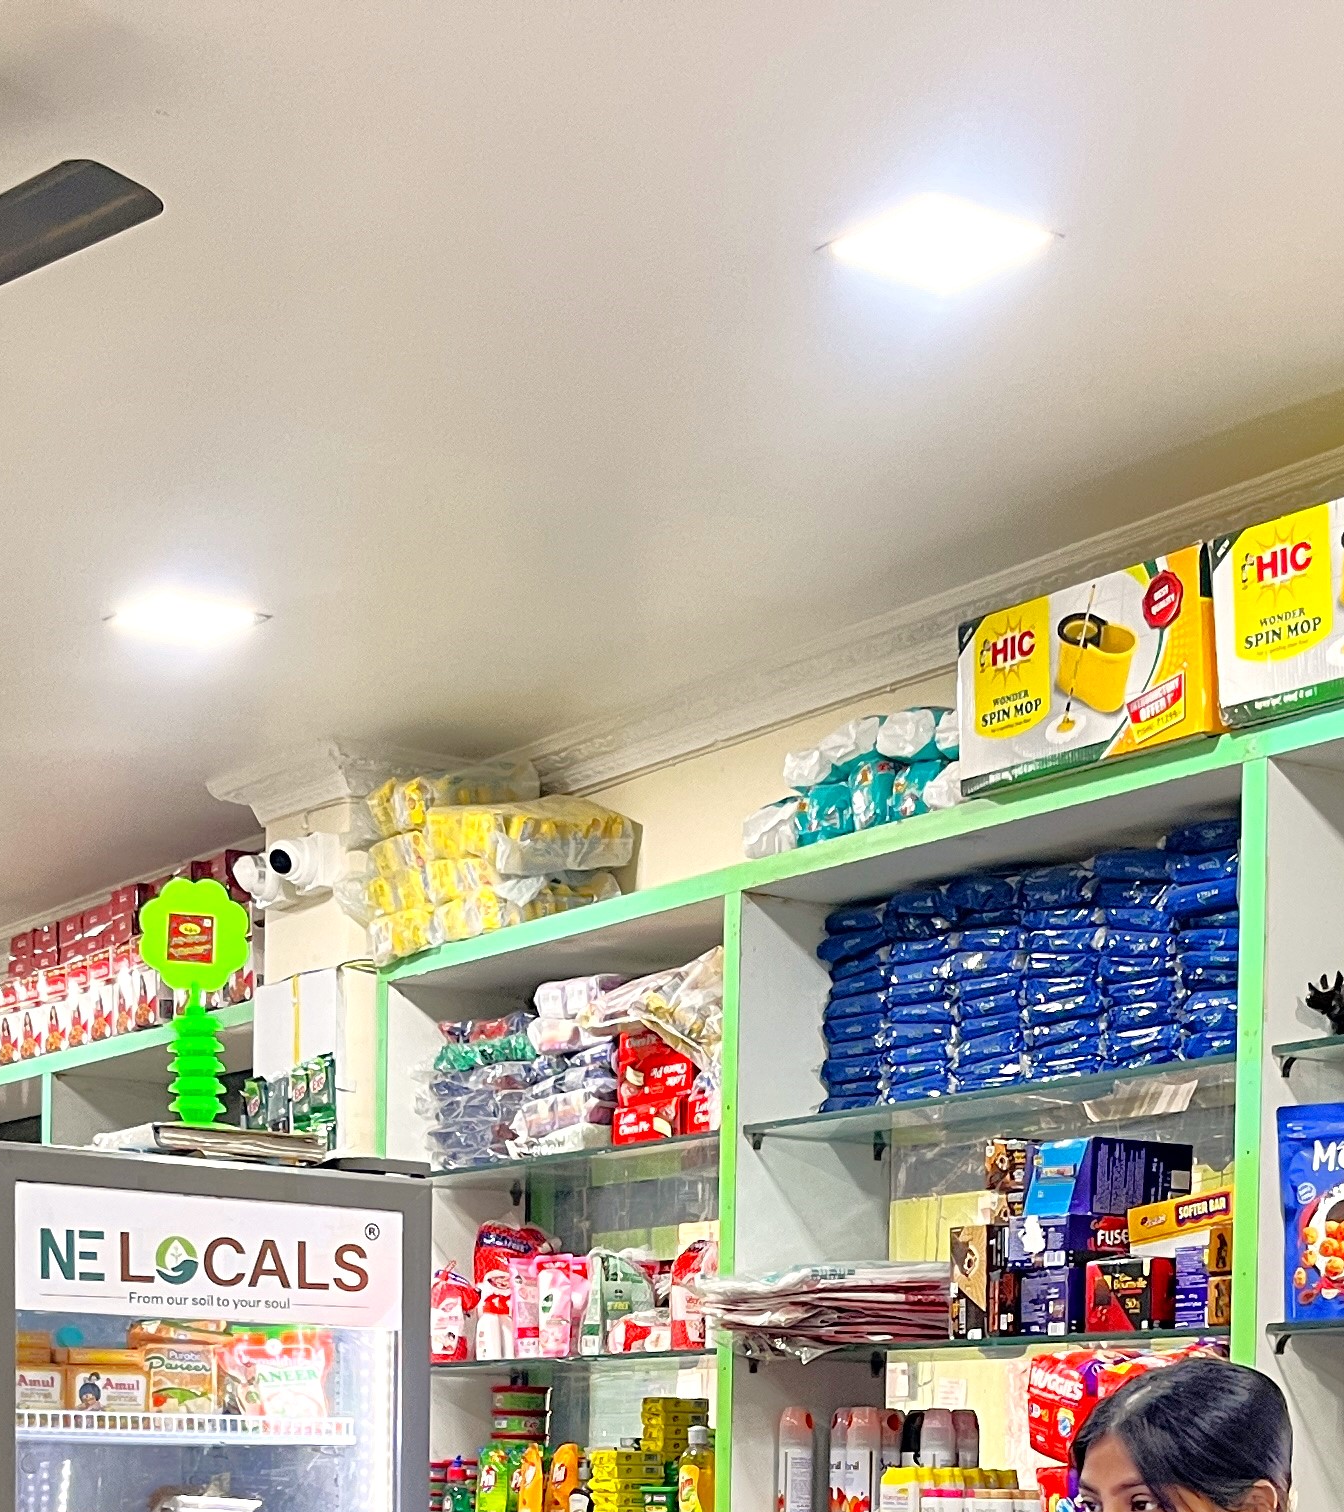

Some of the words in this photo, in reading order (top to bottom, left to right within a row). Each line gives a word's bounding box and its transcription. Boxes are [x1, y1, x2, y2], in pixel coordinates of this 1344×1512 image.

[1256, 541, 1312, 583] HIC
[1259, 607, 1305, 628] WONDER
[1244, 628, 1284, 650] SPIN
[1287, 616, 1321, 639] MOP
[990, 630, 1036, 667] HIC
[992, 689, 1030, 707] WONDER
[981, 709, 1012, 728] SPIN
[1013, 697, 1042, 718] MOP
[1178, 1201, 1207, 1219] SOFTER
[1209, 1196, 1227, 1211] BAR
[1097, 1230, 1129, 1246] FUSE
[40, 1228, 105, 1282] NE
[120, 1232, 369, 1292] LOCALS
[128, 1291, 164, 1306] From
[166, 1294, 189, 1306] our
[191, 1293, 214, 1307] soil
[216, 1295, 230, 1307] to
[232, 1297, 262, 1311] your
[264, 1297, 291, 1310] soul
[144, 1355, 212, 1373] Paneer
[16, 1373, 55, 1389] Amul
[102, 1376, 141, 1392] Amul
[257, 1367, 318, 1383] ANEER
[1031, 1366, 1084, 1401] HUGGIES
